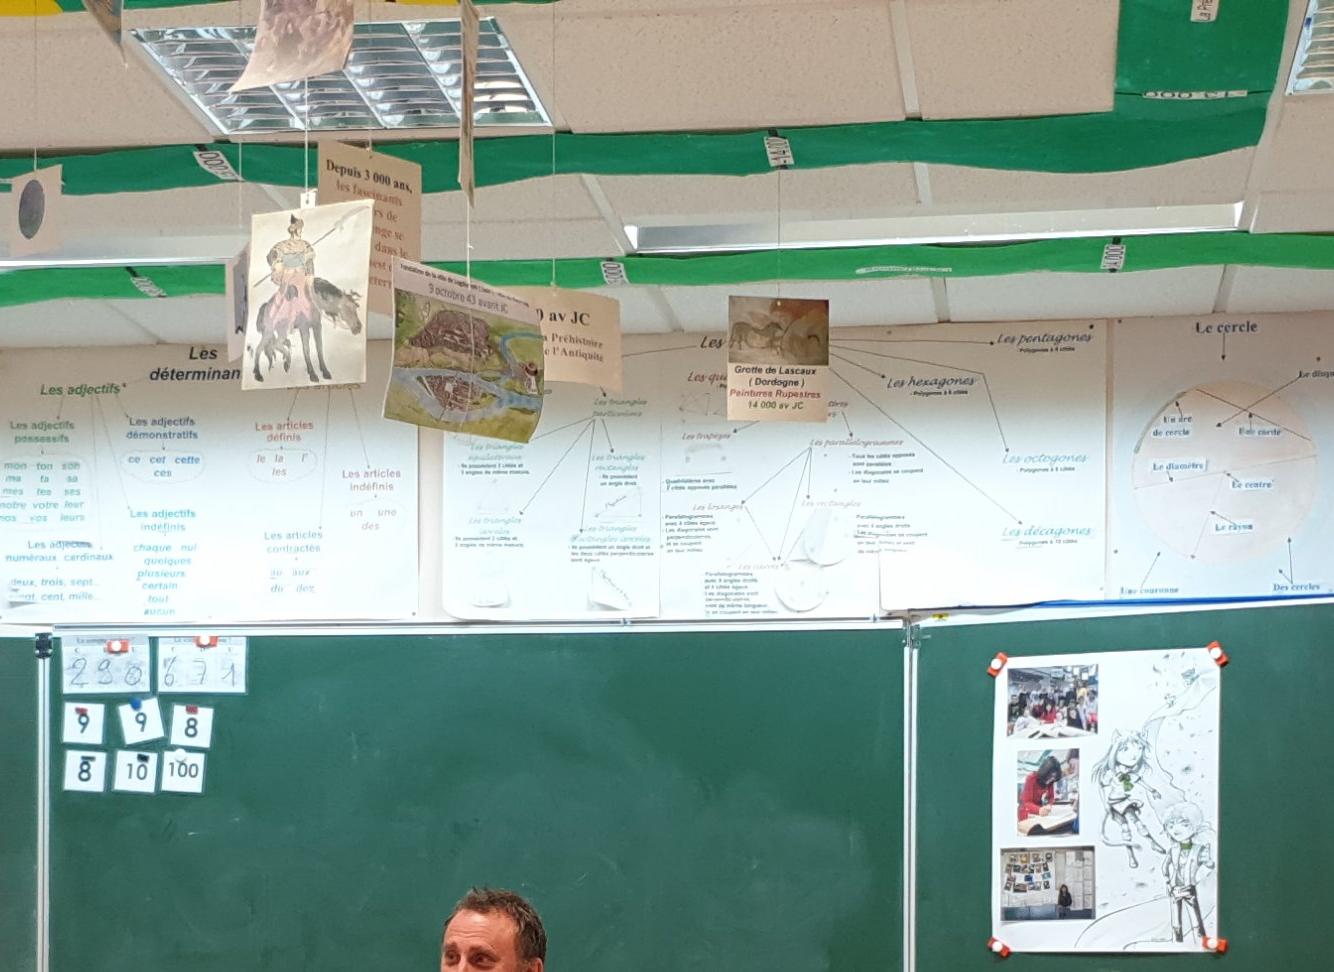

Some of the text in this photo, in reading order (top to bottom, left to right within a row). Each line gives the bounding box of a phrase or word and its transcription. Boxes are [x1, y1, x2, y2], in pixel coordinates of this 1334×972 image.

[326, 159, 362, 178] Depuis
[364, 169, 370, 181] 3
[373, 172, 391, 186] 000
[336, 180, 351, 192] les
[549, 311, 591, 326] av JC
[1196, 321, 1258, 334] Le cercle
[551, 333, 605, 350] Préhistoire
[700, 335, 725, 350] Les
[997, 333, 1093, 348] Les pentagones
[189, 346, 217, 360] Les
[150, 366, 241, 382] déterminan
[734, 365, 817, 375] Grotte de Lascaux
[887, 375, 976, 389] Les hexagones
[40, 382, 121, 397] Les adjectifs
[730, 389, 822, 400] Peintures Rupestres
[748, 401, 758, 410] 14
[761, 401, 776, 410] 000
[792, 401, 804, 410] JC
[10, 420, 75, 431] Les adjectifs
[129, 416, 195, 428] Les adjectifs
[255, 421, 314, 431] Les articles
[14, 435, 69, 445] possessifs
[126, 429, 198, 440] démonstratifs
[266, 433, 301, 442] définis
[128, 456, 141, 464] ce
[174, 454, 200, 465] cette
[1023, 452, 1088, 465] octogones
[4, 460, 53, 471] mon ton
[342, 469, 401, 479] Les articles
[349, 482, 394, 492] indéfinis
[130, 508, 196, 520] Les adjectifs
[1023, 525, 1091, 538] décagones
[1273, 582, 1321, 592] Des cercles
[78, 713, 90, 734] 9
[135, 712, 147, 733] 9
[184, 717, 198, 738] 8
[78, 761, 91, 782] 8
[126, 762, 148, 781] 10
[168, 761, 199, 779] 100
